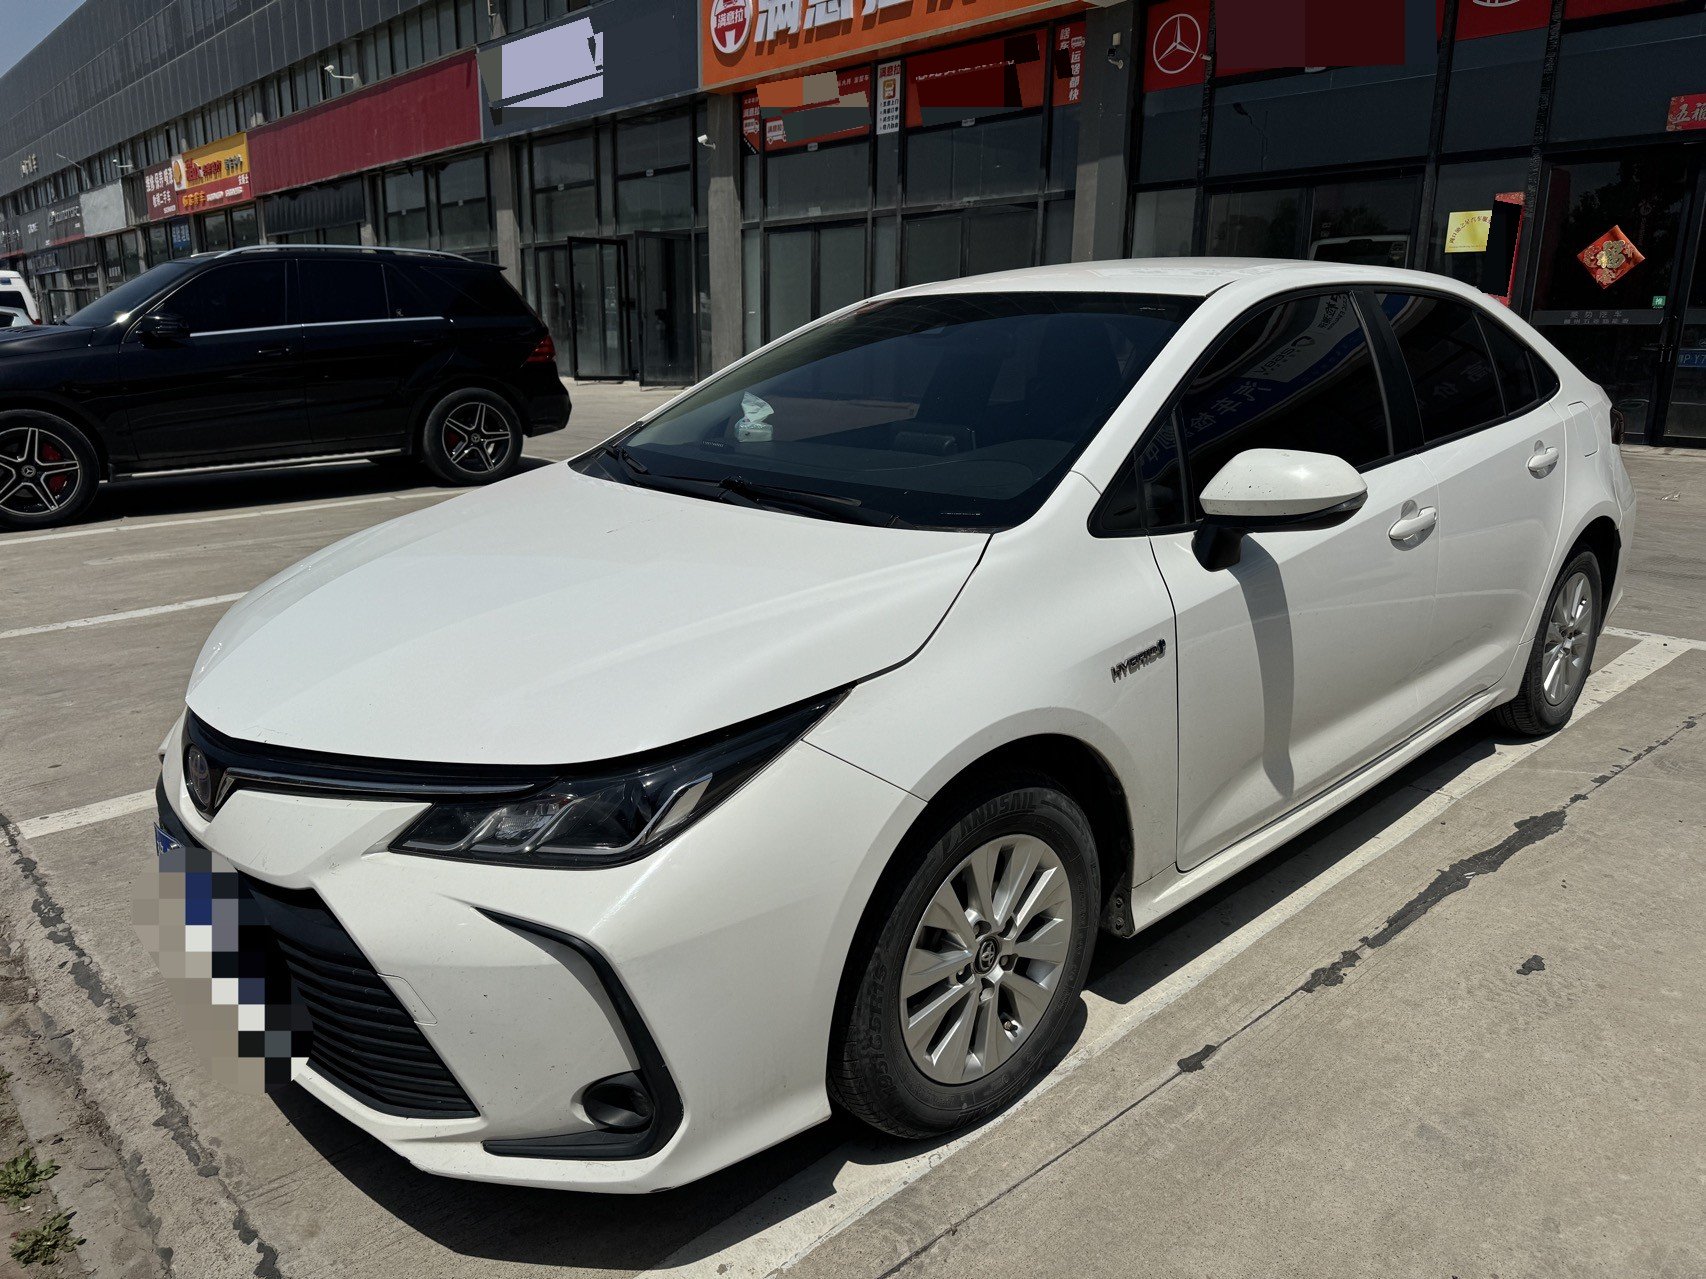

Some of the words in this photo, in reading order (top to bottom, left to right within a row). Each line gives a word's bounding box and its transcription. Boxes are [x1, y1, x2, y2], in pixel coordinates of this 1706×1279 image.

[716, 8, 744, 28] 满意拉
[1110, 639, 1167, 684] HYBRID
